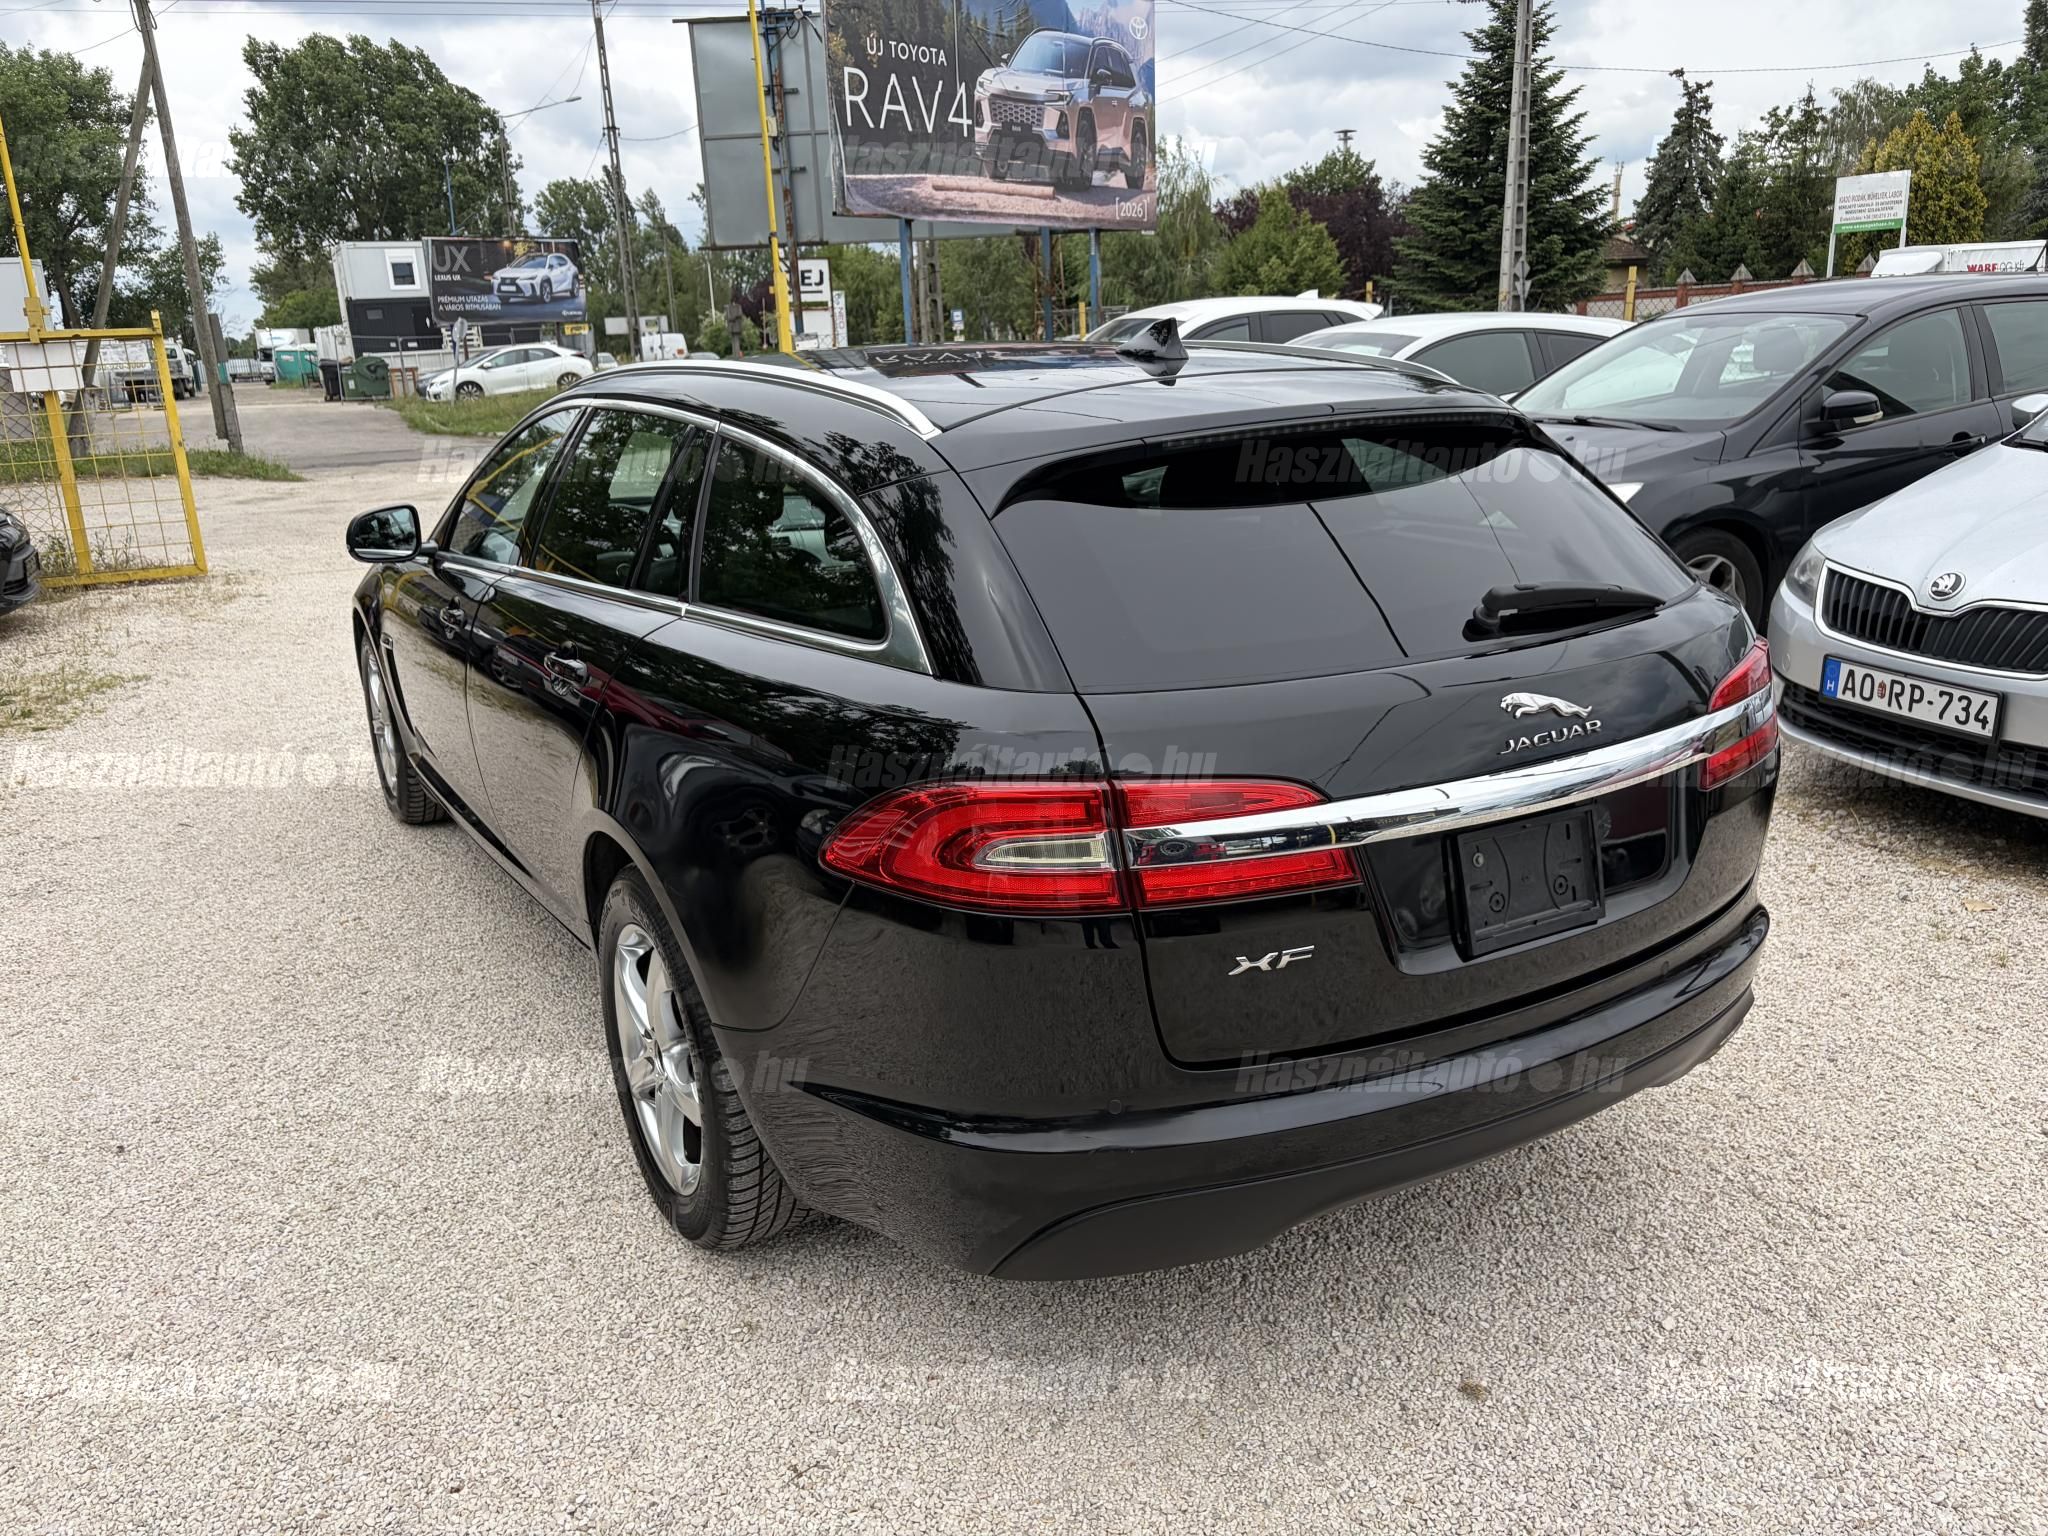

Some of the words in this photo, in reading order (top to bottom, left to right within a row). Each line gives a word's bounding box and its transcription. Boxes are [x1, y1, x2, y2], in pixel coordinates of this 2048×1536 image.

[866, 33, 883, 56] ÚJ
[889, 40, 948, 67] TOYOTA
[843, 66, 973, 138] RAV4
[1889, 190, 1903, 199] LABOR
[432, 246, 471, 272] UX
[800, 269, 824, 287] EJ
[437, 295, 465, 303] PRÉMIUM
[1826, 680, 1834, 691] H
[1497, 720, 1602, 754] JAGUAR
[1228, 945, 1315, 975] XF
